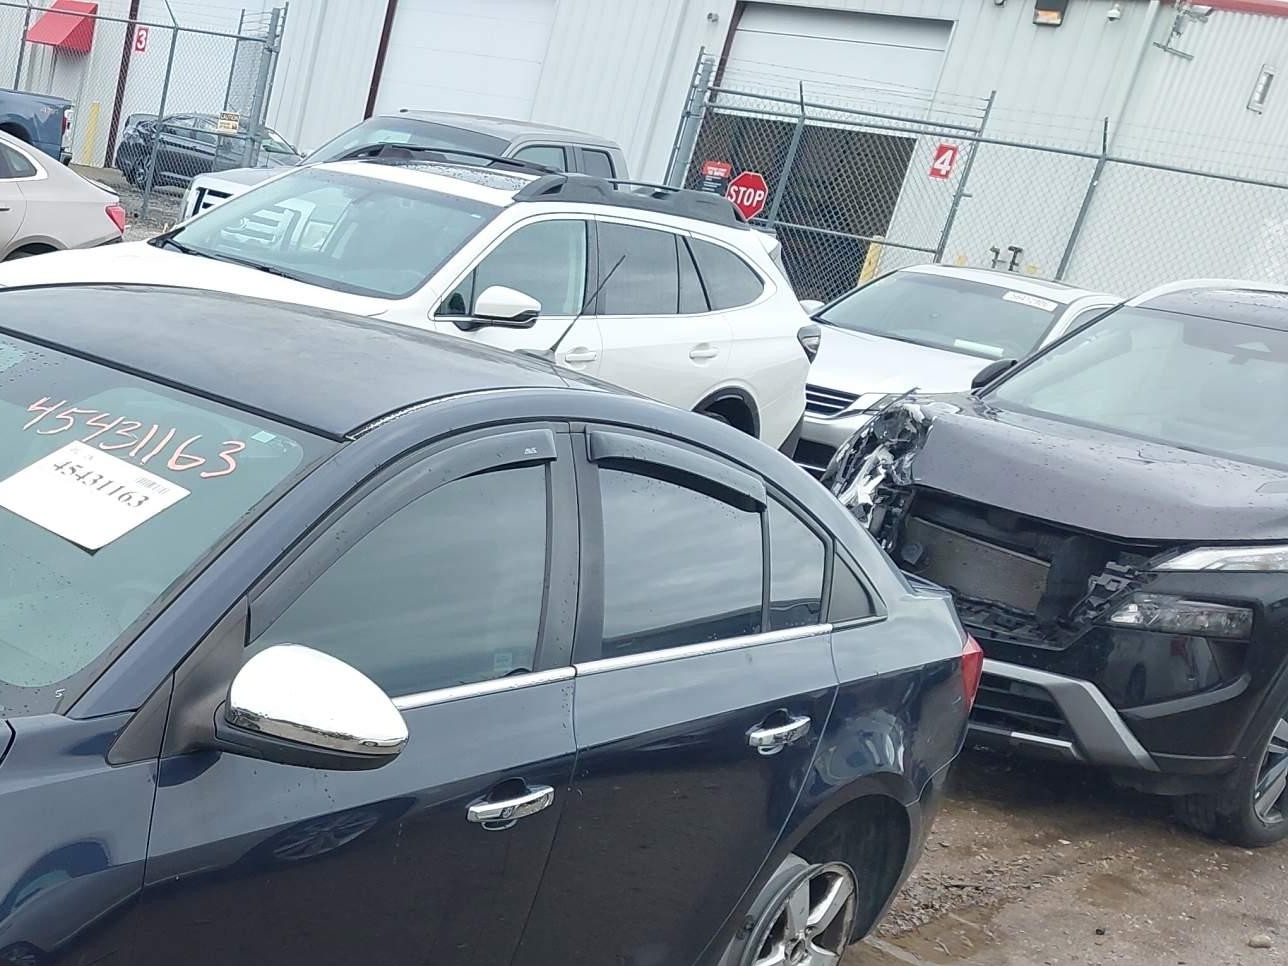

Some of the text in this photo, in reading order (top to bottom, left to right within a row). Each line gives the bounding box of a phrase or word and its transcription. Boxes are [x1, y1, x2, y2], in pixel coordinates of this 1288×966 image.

[136, 30, 147, 49] 3
[934, 149, 954, 175] 4
[727, 185, 765, 207] STOP
[23, 396, 247, 479] 45431163
[53, 461, 150, 507] 45431163
